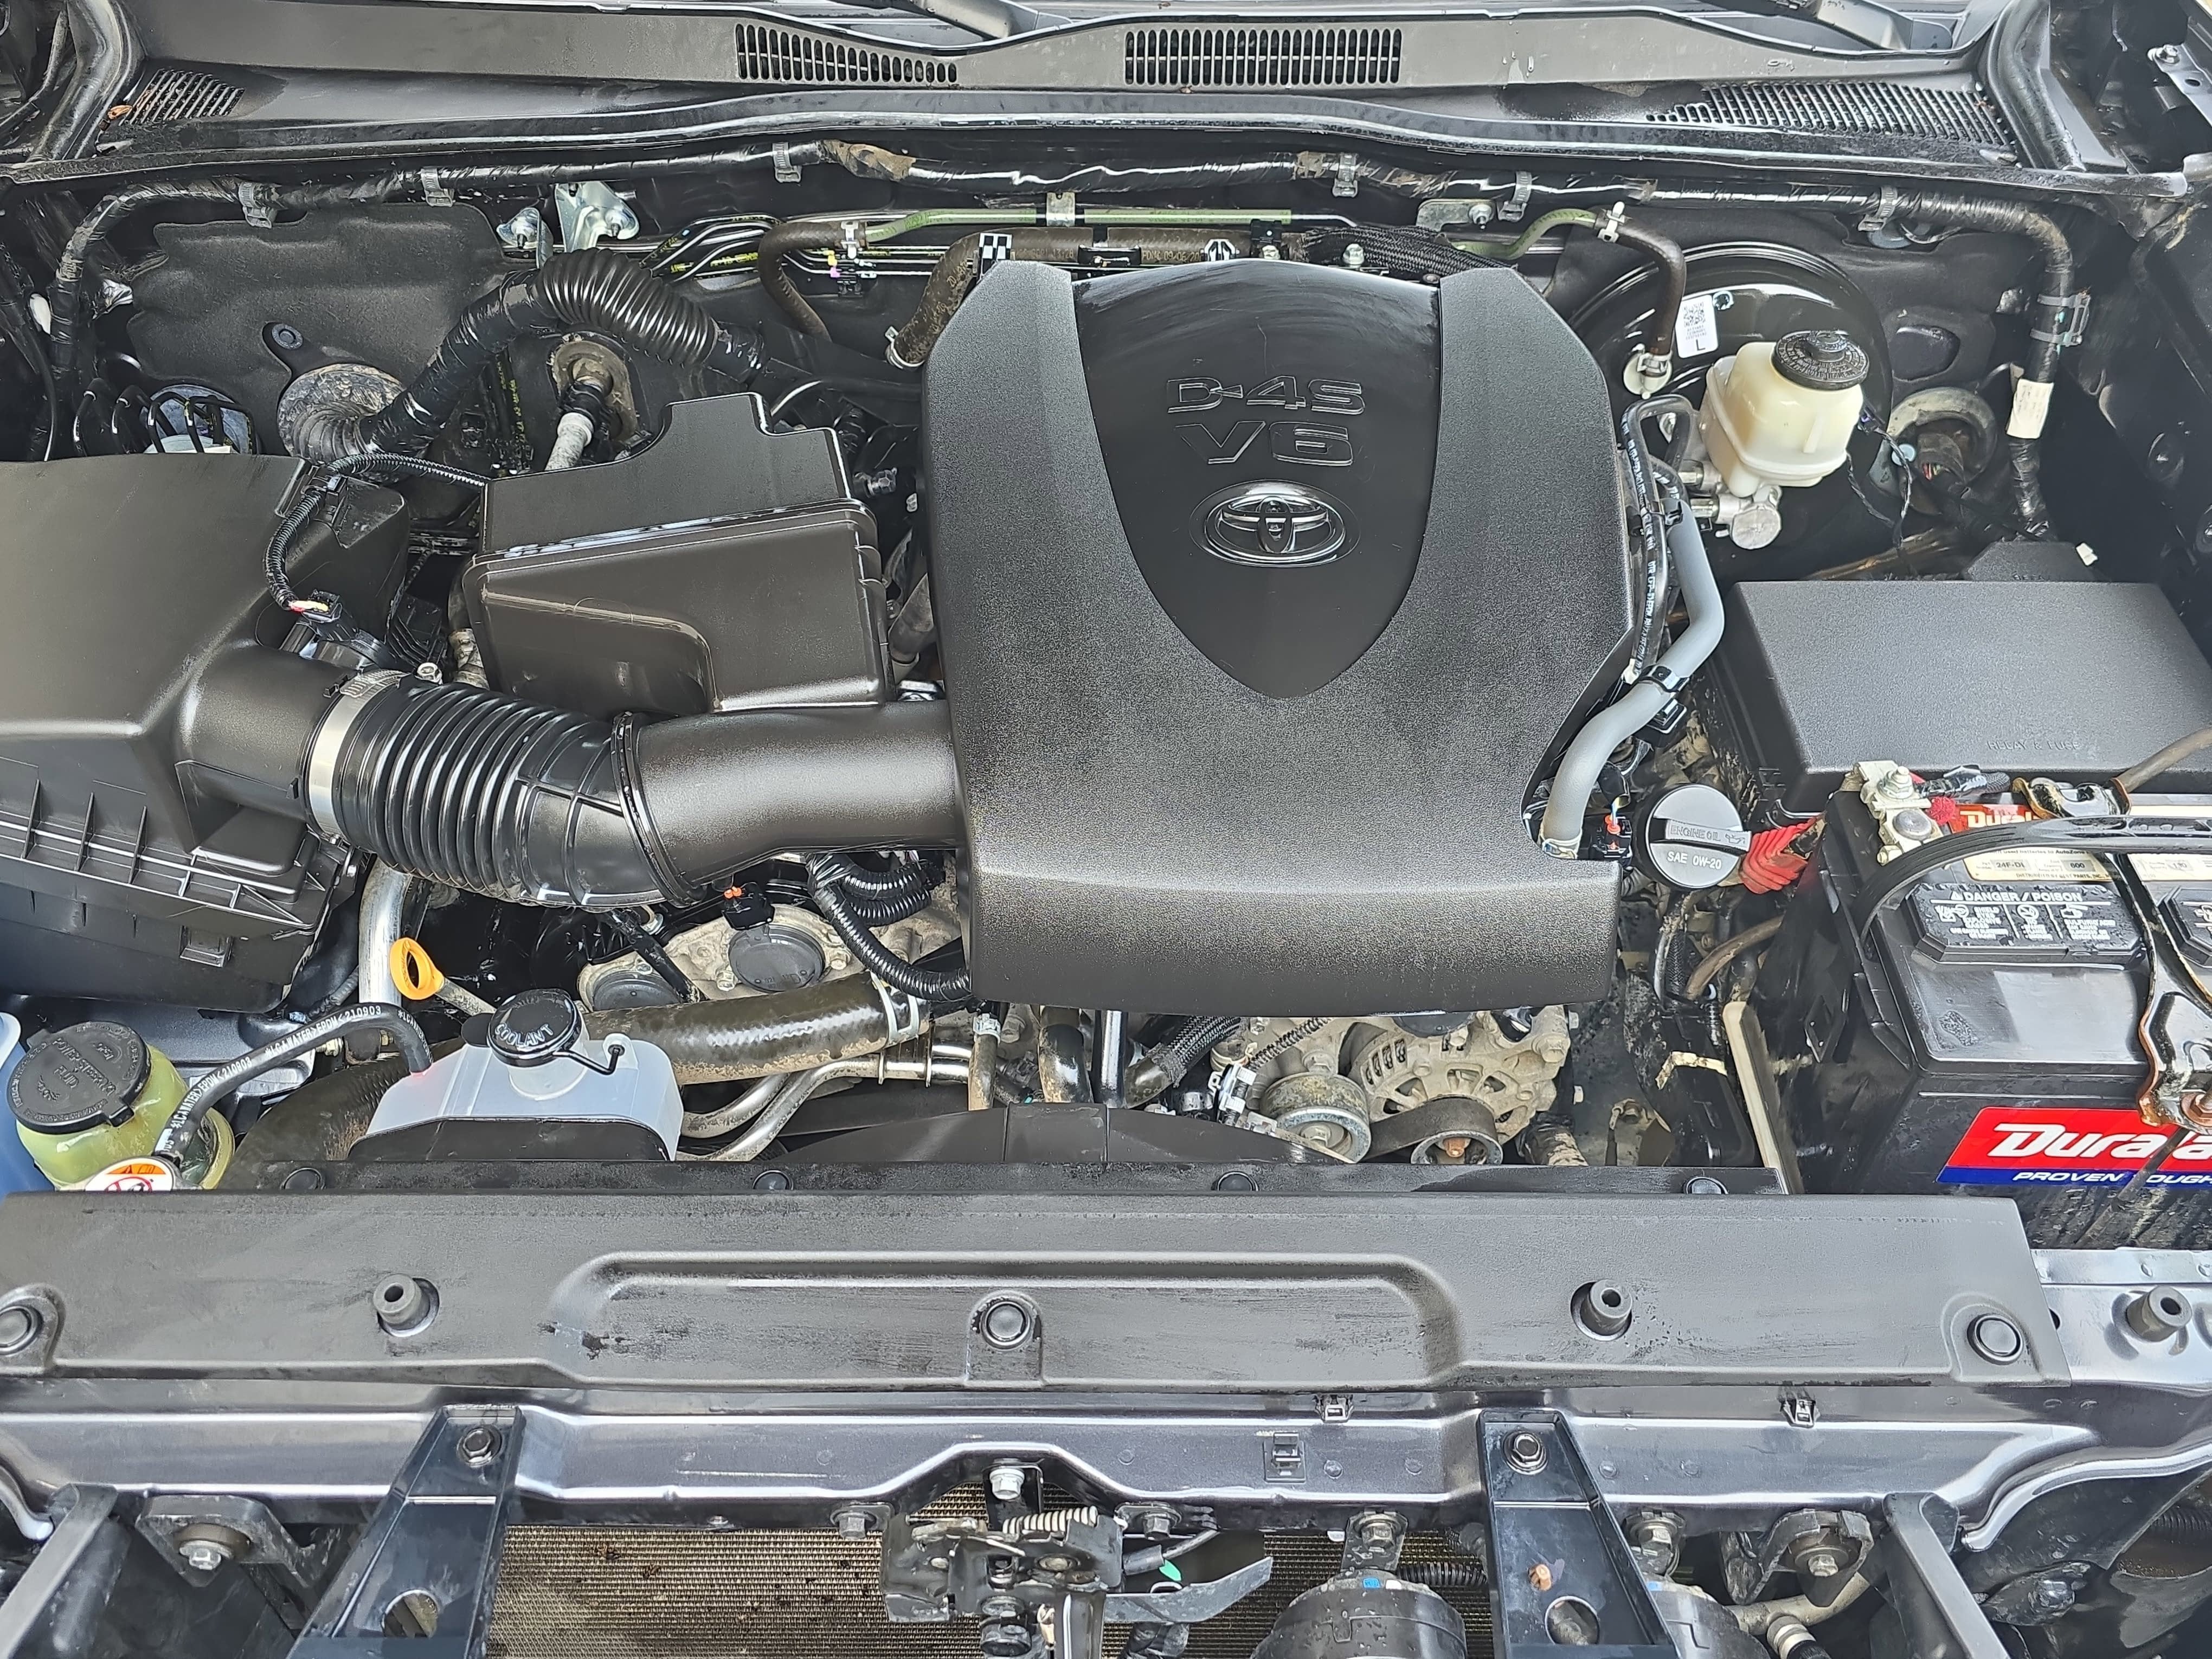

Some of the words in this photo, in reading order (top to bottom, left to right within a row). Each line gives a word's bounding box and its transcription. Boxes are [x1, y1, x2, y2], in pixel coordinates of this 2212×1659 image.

[1696, 339, 1706, 351] L
[1173, 420, 1354, 466] V6
[1670, 825, 1706, 840] ENGINE
[1706, 831, 1721, 842] OIL
[1667, 850, 1688, 864] SAE
[1693, 855, 1722, 870] 0W-20
[1963, 892, 2020, 902] DANGER
[2032, 892, 2084, 902] POISON
[494, 1023, 554, 1048] COOLANT
[53, 1065, 80, 1089] FLUID
[2012, 1172, 2126, 1182] PROVEN
[2133, 1173, 2212, 1185] OUGH
